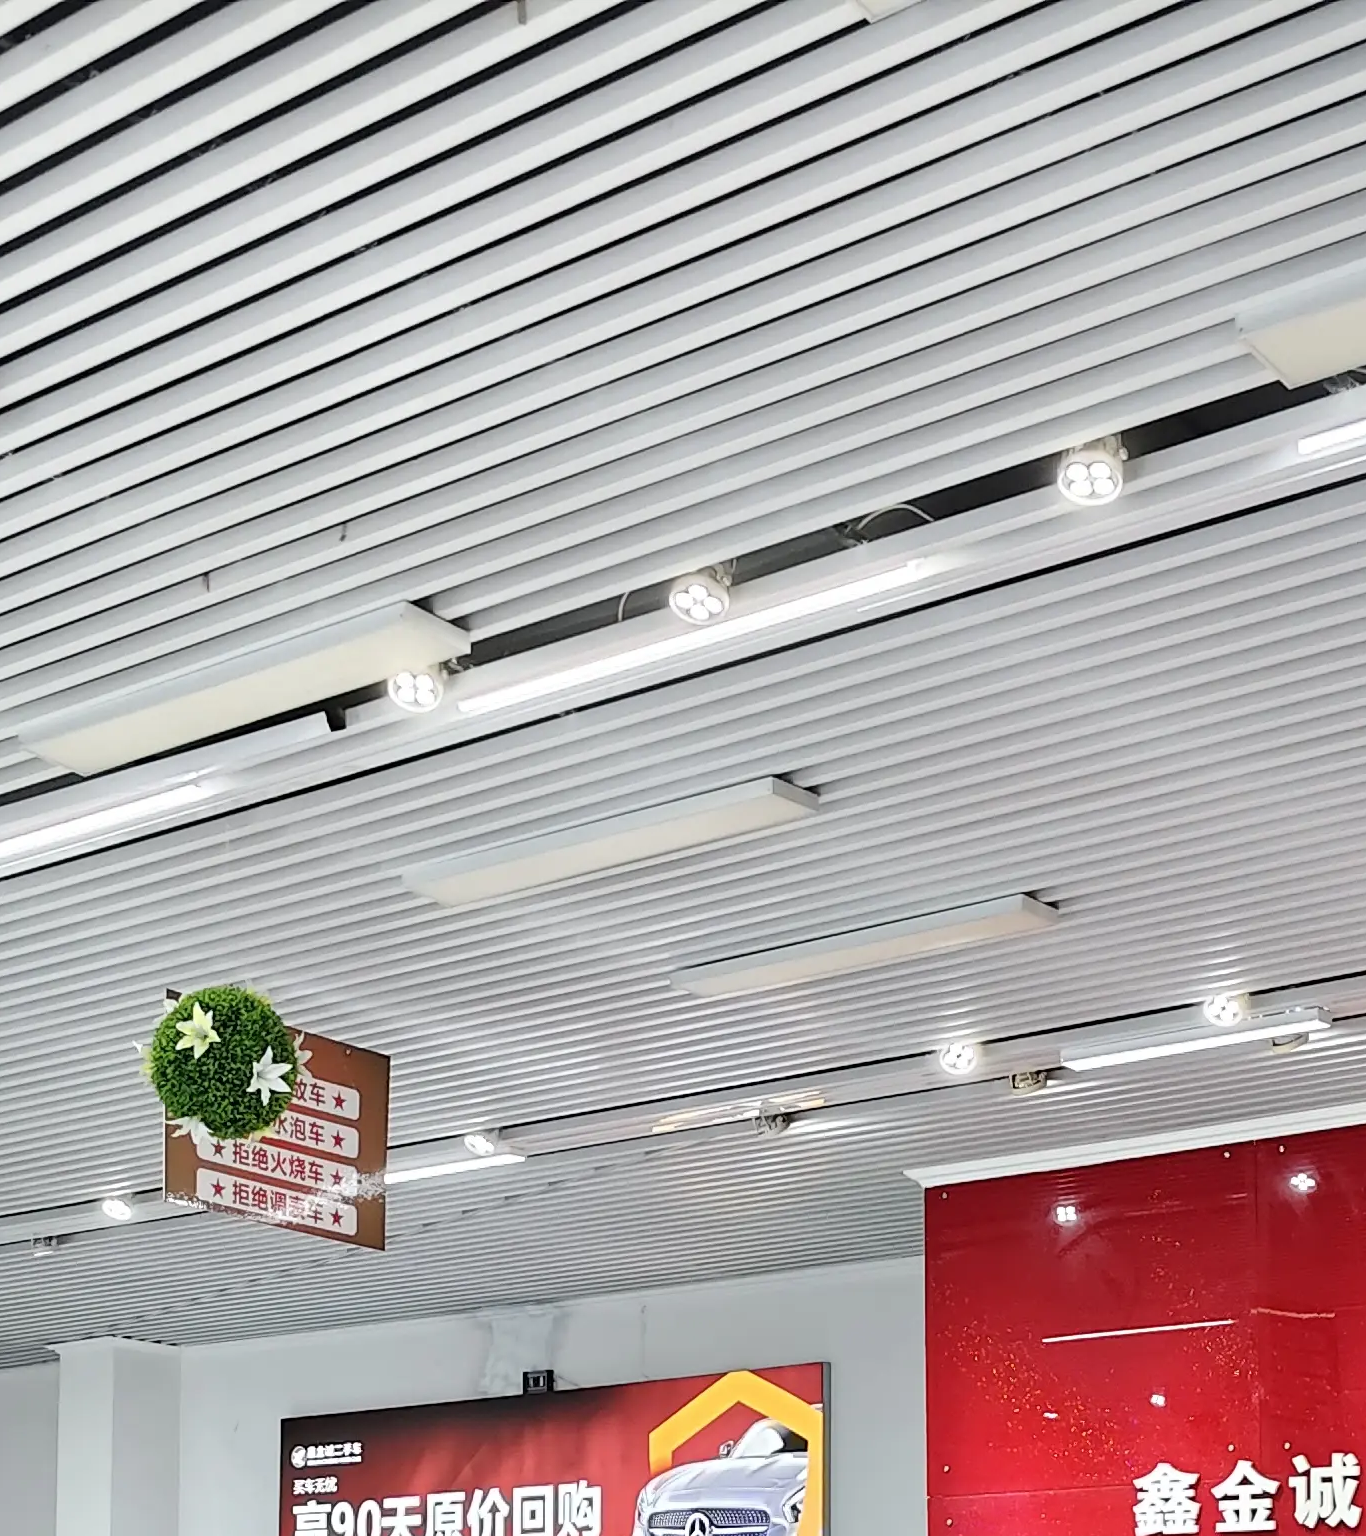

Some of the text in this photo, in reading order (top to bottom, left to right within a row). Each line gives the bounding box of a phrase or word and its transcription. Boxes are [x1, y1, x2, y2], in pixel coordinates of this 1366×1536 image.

[294, 1078, 326, 1107] 故车
[273, 1115, 326, 1146] 水泡车
[232, 1142, 325, 1185] 拒绝火烧车
